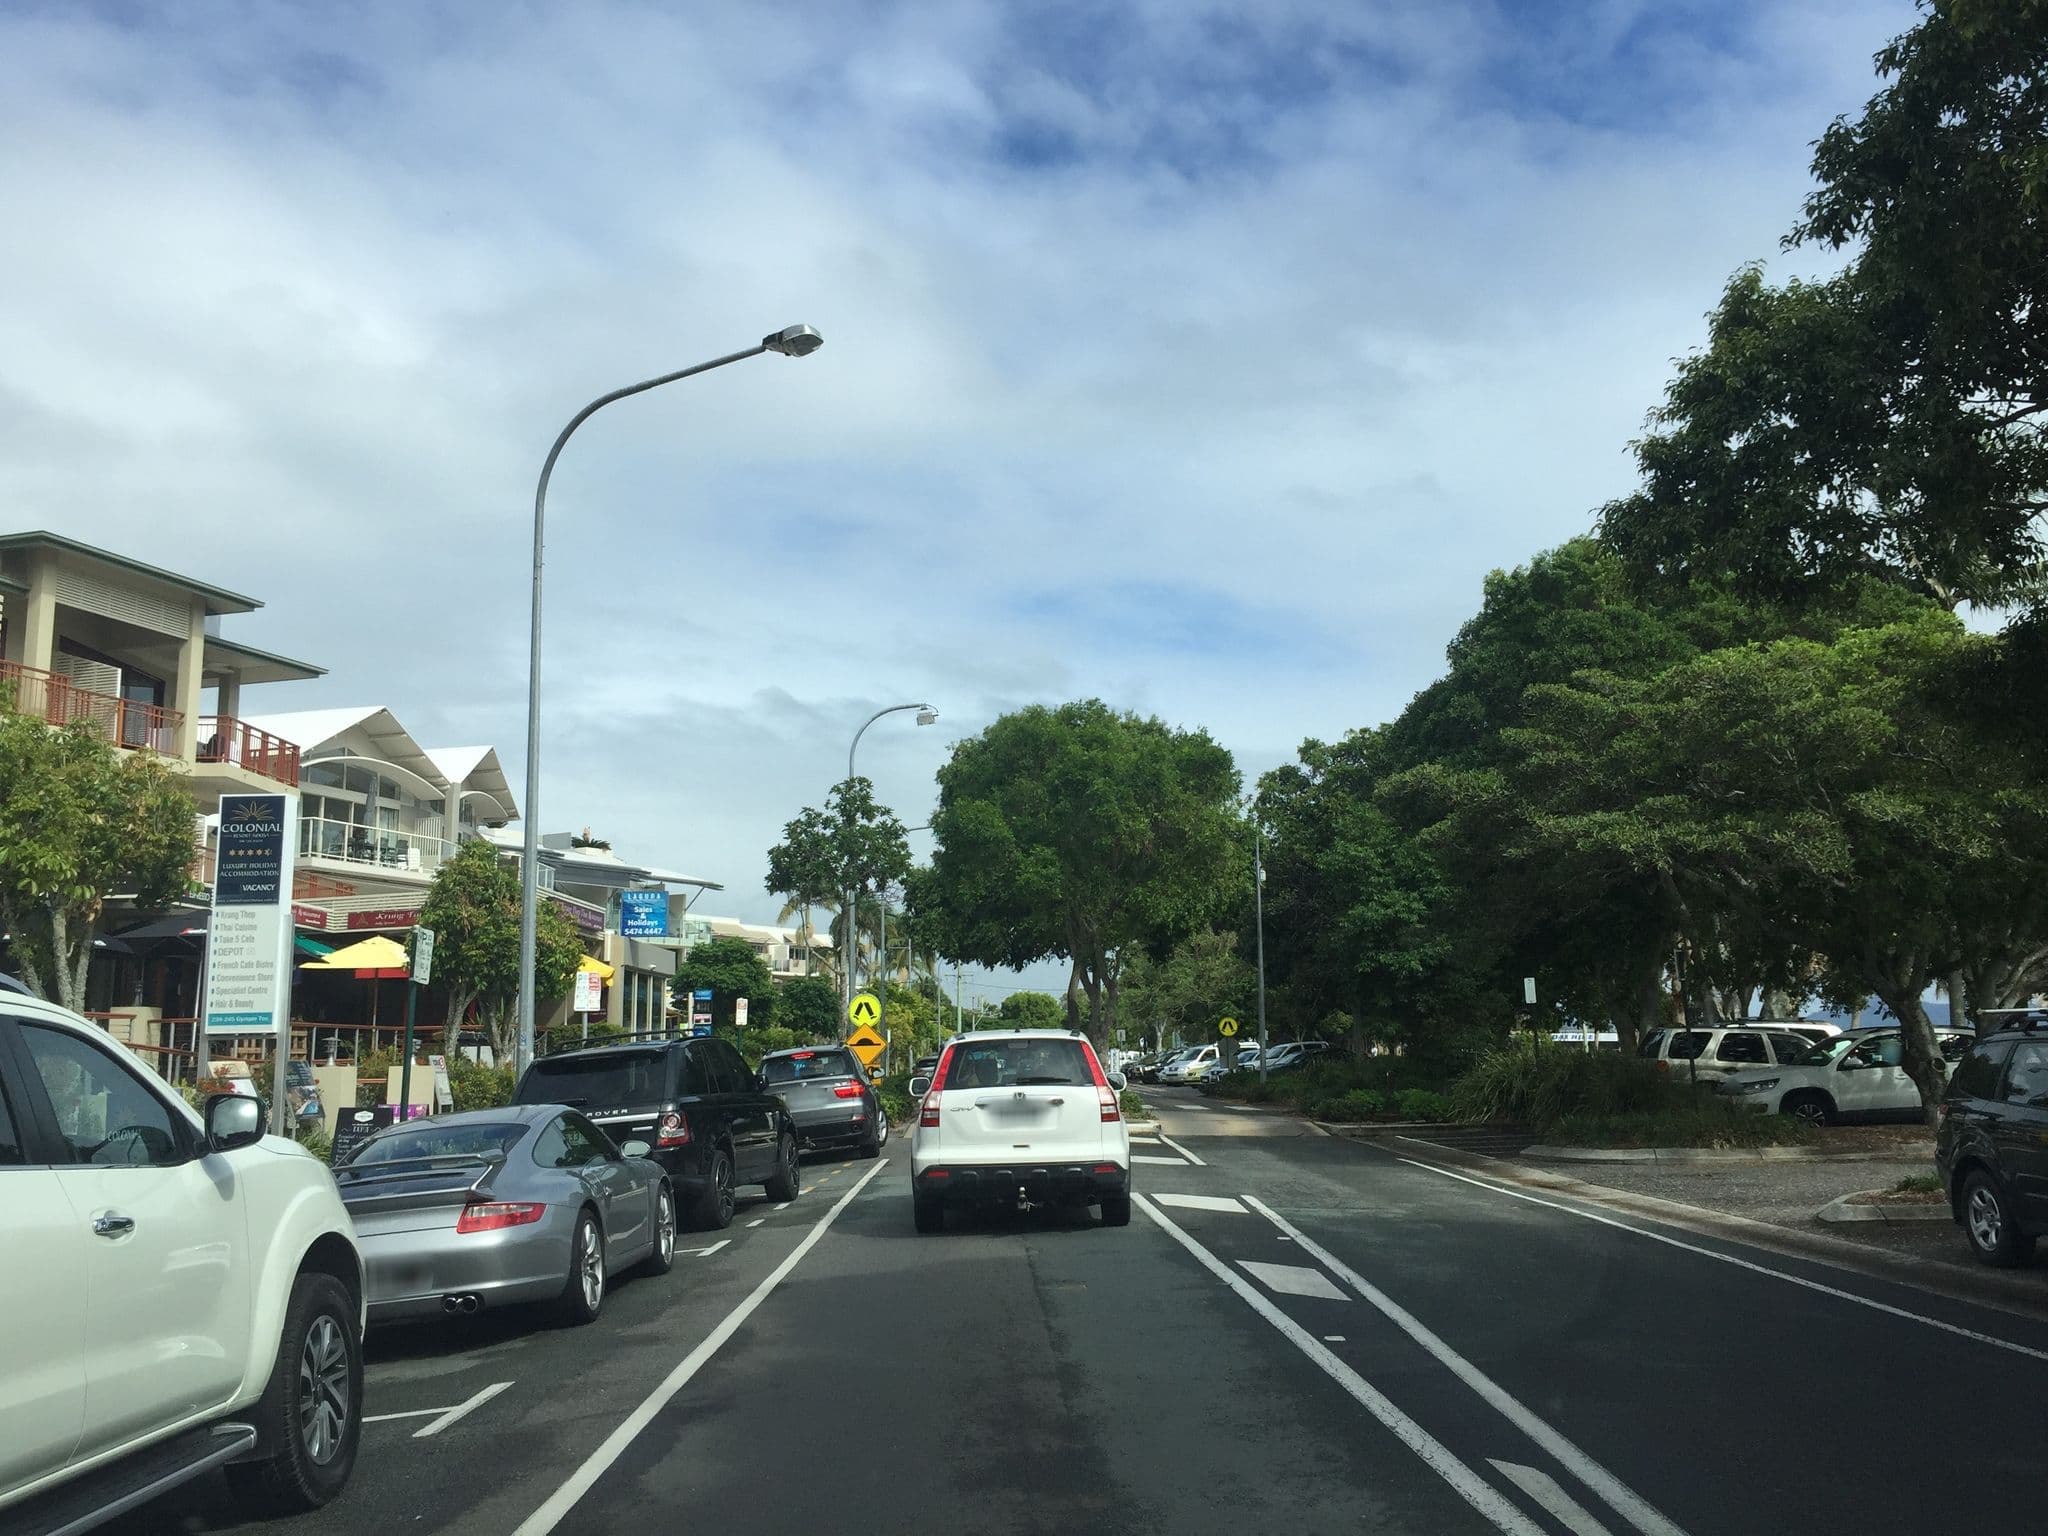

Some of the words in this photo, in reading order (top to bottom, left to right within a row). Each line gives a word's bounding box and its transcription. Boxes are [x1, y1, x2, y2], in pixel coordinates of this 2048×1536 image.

[221, 823, 283, 833] COLONIAL
[242, 884, 276, 892] VACANCY
[375, 912, 405, 921] Krung
[627, 919, 659, 927] Holidays
[624, 928, 643, 936] 5474
[218, 935, 234, 943] Take
[217, 947, 244, 957] DEPOT
[255, 960, 274, 969] Bistro
[257, 973, 273, 981] Store
[215, 986, 246, 996] Specialist
[247, 986, 268, 994] Centre
[215, 1000, 226, 1008] Hair
[234, 1000, 255, 1009] Beauty
[586, 1108, 629, 1117] ROVER
